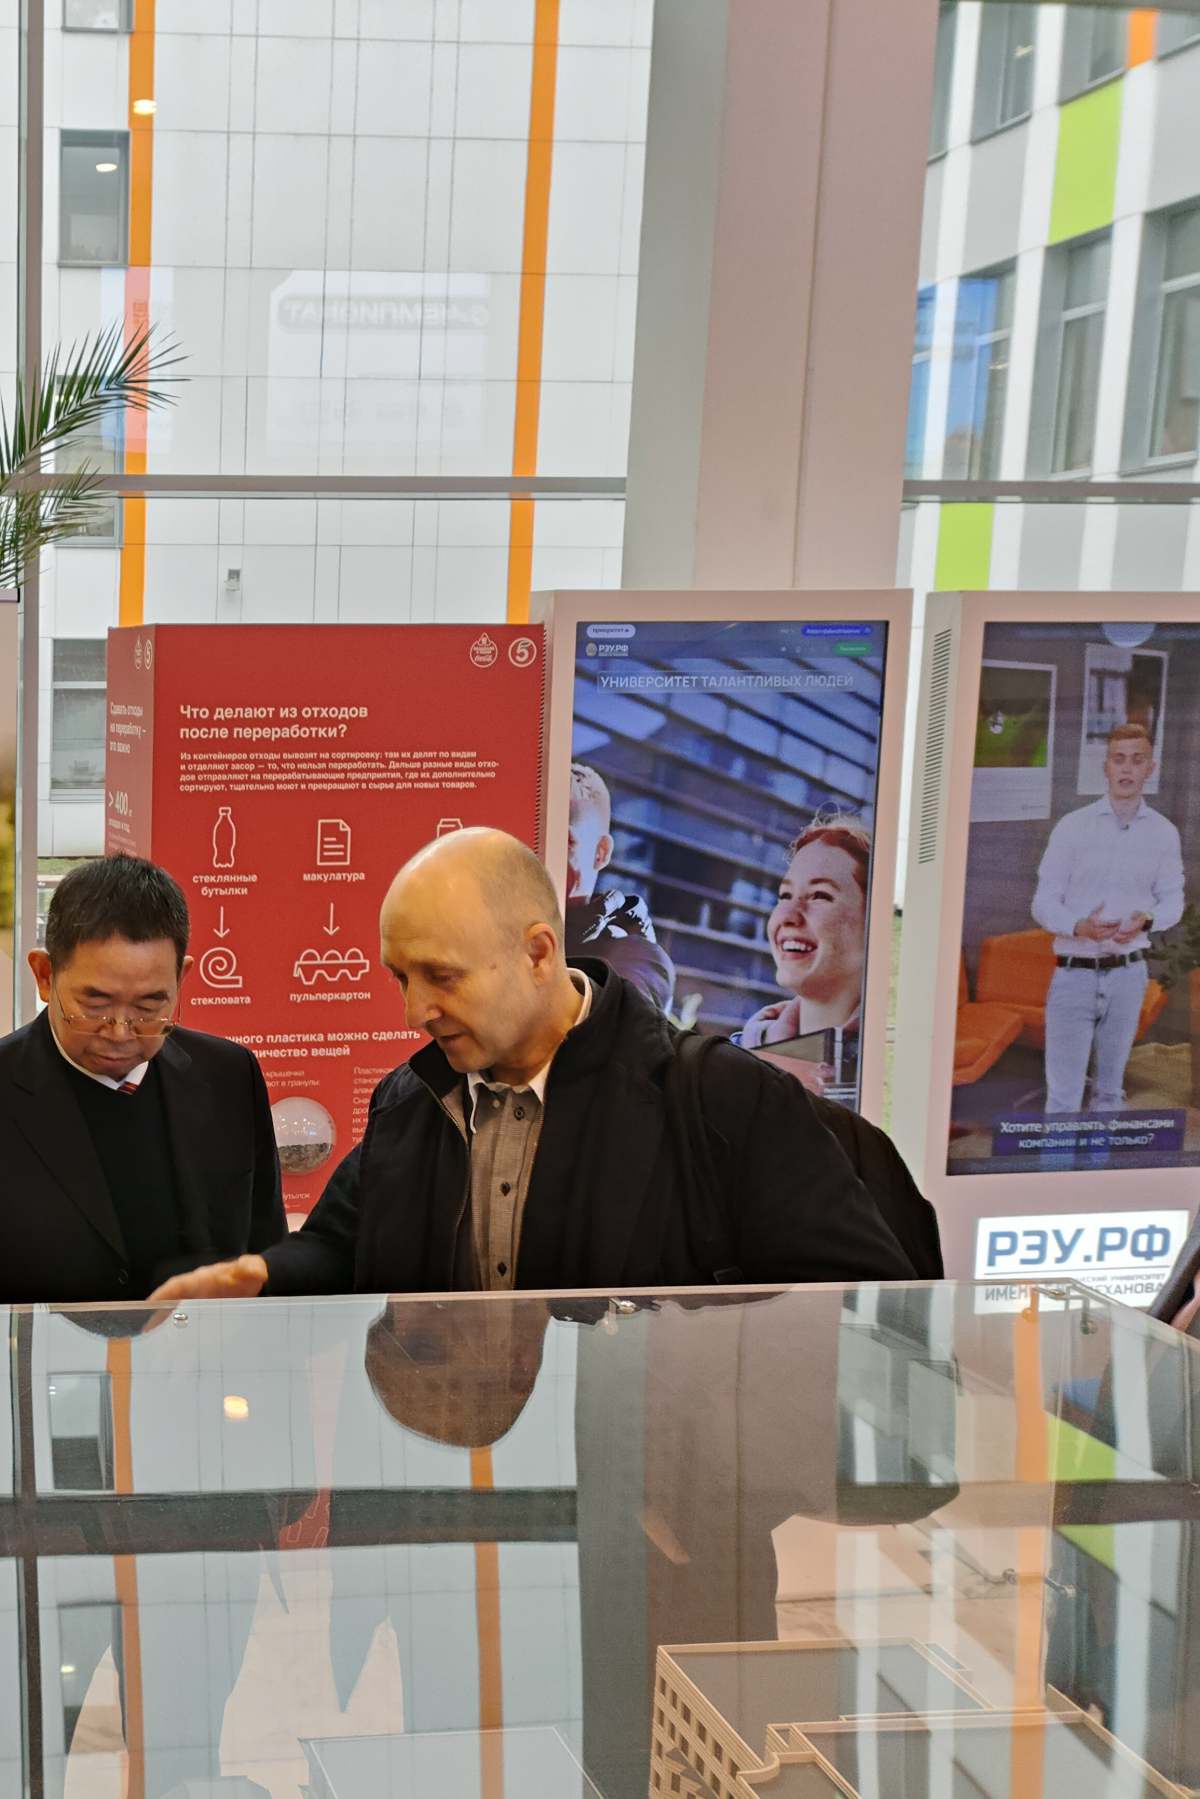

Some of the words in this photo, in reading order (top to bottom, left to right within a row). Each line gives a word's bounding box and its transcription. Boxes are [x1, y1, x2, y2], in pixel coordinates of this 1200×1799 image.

[516, 640, 531, 662] 5
[600, 676, 698, 689] УНИВЕРСИТЕТ
[701, 675, 800, 688] ТАЛАНТЛИВЫХ
[804, 674, 853, 688] ЛЮДЕЙ
[180, 704, 210, 719] Что
[213, 705, 275, 722] делают
[279, 706, 298, 719] из
[302, 704, 368, 721] отходов
[180, 726, 228, 740] после
[233, 724, 347, 742] переработки?
[180, 752, 190, 761] Из
[193, 752, 247, 762] контейнеров
[250, 752, 280, 762] отходы
[283, 752, 317, 761] вывозят
[320, 752, 330, 760] на
[332, 751, 382, 761] сортировку:
[385, 751, 399, 759] там
[401, 751, 411, 759] их
[413, 751, 437, 760] делят
[439, 751, 449, 759] по
[451, 751, 476, 759] видам
[188, 763, 229, 772] отделяют
[231, 763, 255, 772] засор
[281, 762, 295, 770] что
[297, 762, 326, 770] нельзя
[328, 761, 386, 771] переработать.
[388, 761, 421, 770] Дальше
[423, 761, 451, 770] разные
[454, 760, 476, 769] виды
[478, 761, 499, 769] отхо-
[180, 774, 195, 782] дов
[198, 773, 248, 782] отправляют
[263, 772, 345, 781] перерабатывающие
[347, 771, 403, 780] предприятия,
[405, 771, 418, 780] где
[420, 771, 430, 779] их
[432, 770, 495, 779] дополнительно
[179, 783, 227, 793] сортируют,
[230, 783, 274, 792] тщательно
[276, 783, 299, 791] моют
[308, 782, 359, 792] превращают
[368, 782, 394, 790] сырье
[396, 781, 412, 790] для
[414, 781, 439, 789] новых
[442, 781, 477, 790] товаров.
[192, 873, 258, 884] стеклянные
[303, 871, 365, 883] макулатура
[201, 885, 248, 898] бутылки
[190, 995, 251, 1006] стекловата
[290, 990, 371, 1003] пульперкартон
[267, 1033, 324, 1045] пластика
[327, 1032, 368, 1043] можно
[372, 1031, 421, 1042] сделать
[253, 1047, 308, 1058] личество
[311, 1046, 350, 1058] вещей
[1000, 1121, 1042, 1134] Хотите
[1044, 1120, 1104, 1134] управлять
[1108, 1118, 1175, 1132] финансами
[1019, 1138, 1076, 1149] компании
[1079, 1138, 1088, 1147] и
[1091, 1136, 1106, 1147] не
[1109, 1133, 1154, 1147] только?
[283, 1192, 311, 1200] утылок
[987, 1224, 1171, 1267] РЭУ.РФ
[985, 1284, 1031, 1301] ИМЕН
